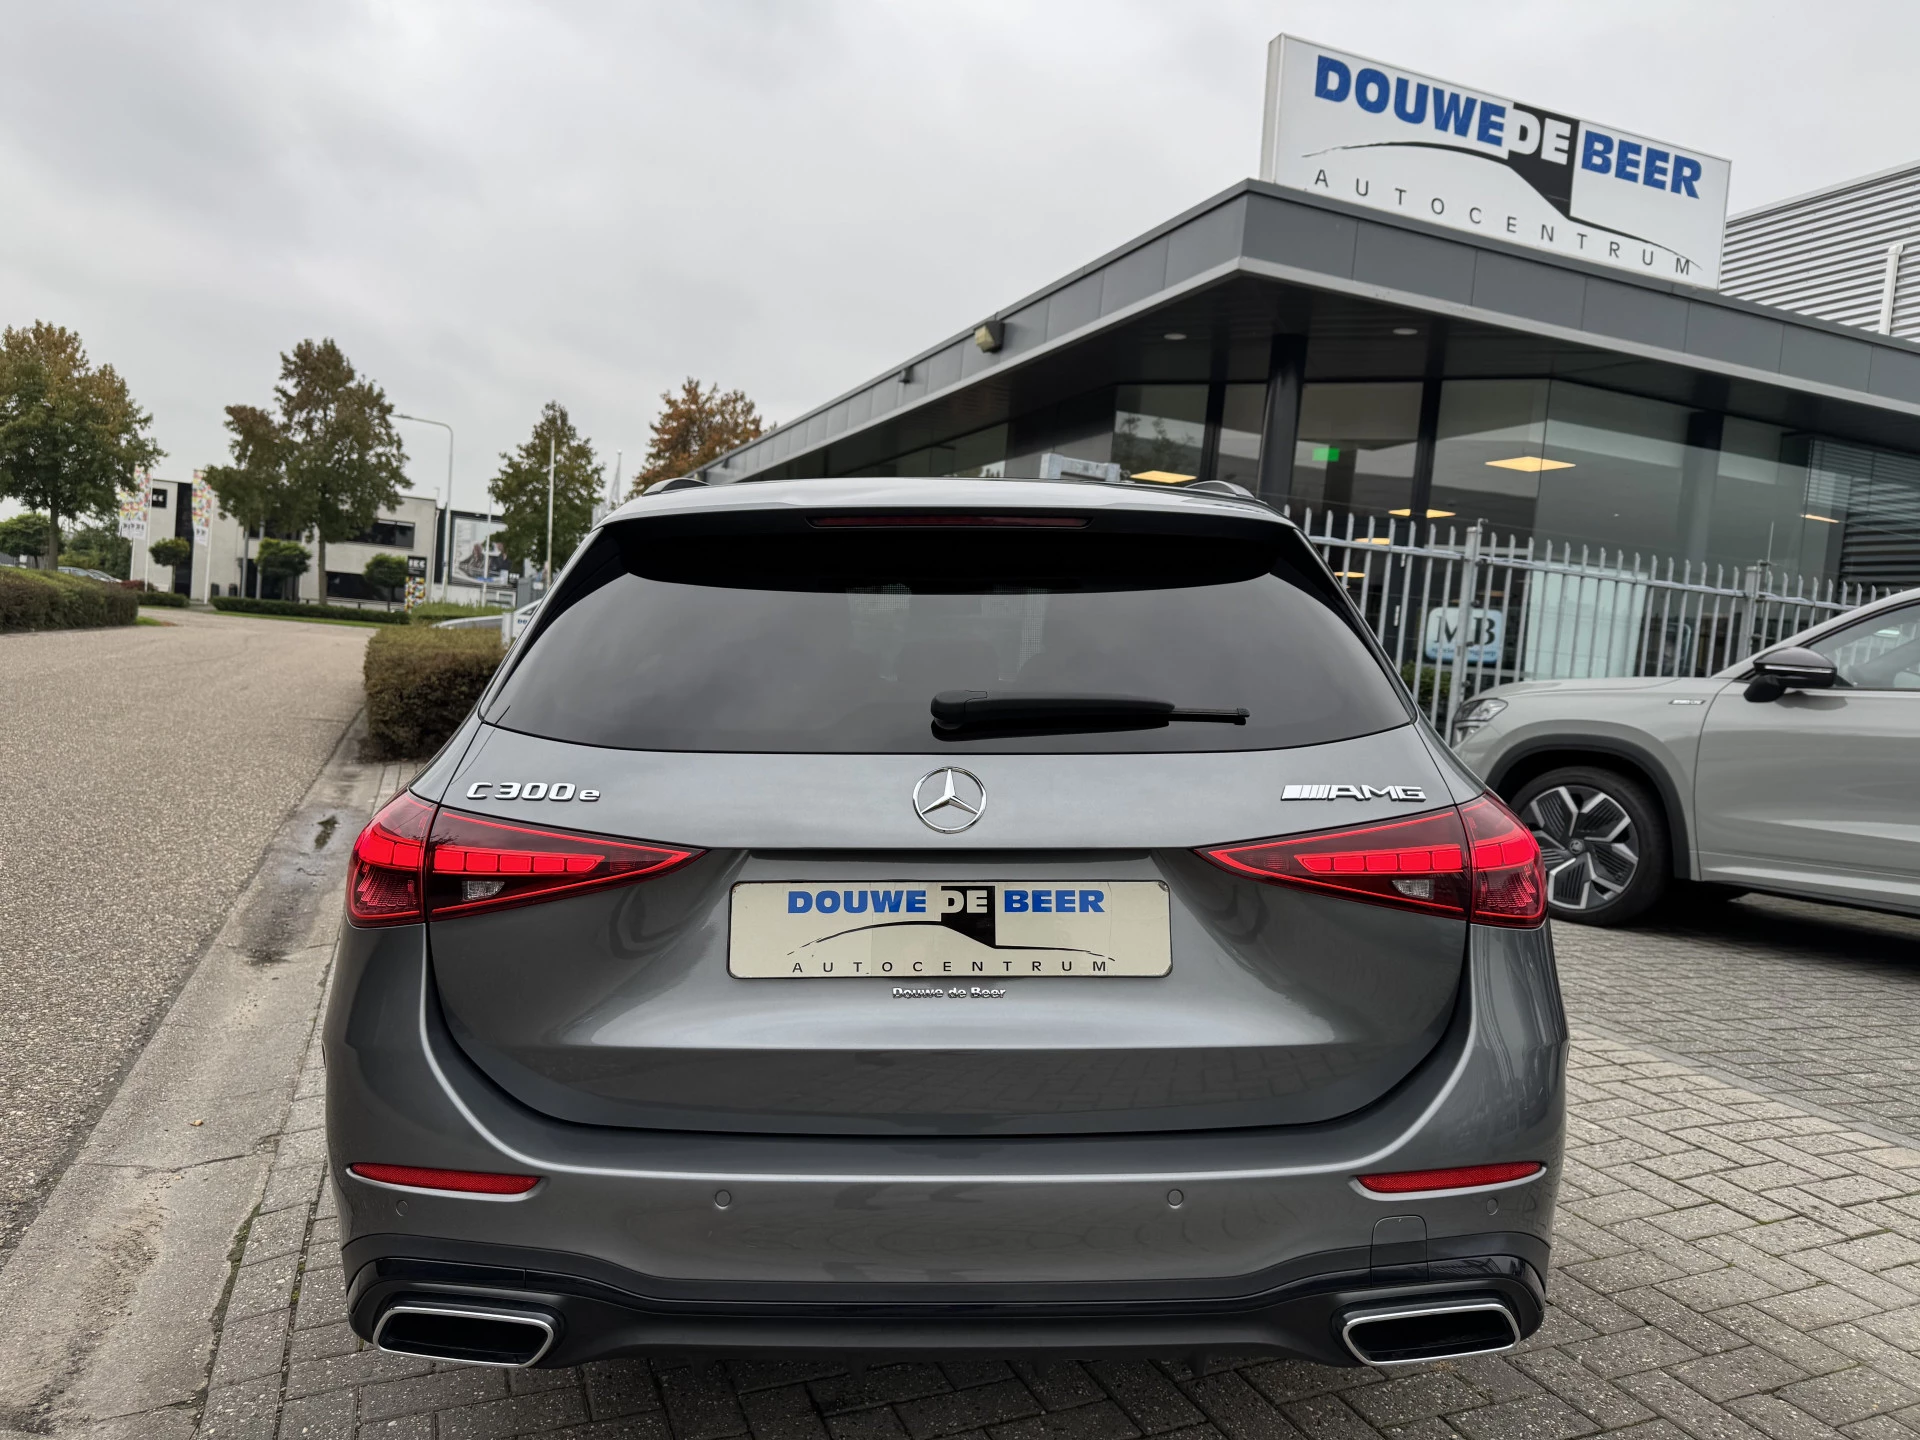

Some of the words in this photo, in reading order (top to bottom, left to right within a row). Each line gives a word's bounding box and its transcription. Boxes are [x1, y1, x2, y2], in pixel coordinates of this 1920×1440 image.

[1314, 54, 1507, 147] DOUWE
[1509, 108, 1572, 166] DE
[1581, 129, 1703, 200] BEER
[1314, 169, 1690, 276] AUTOCENTRUM
[1327, 784, 1427, 802] AMG
[787, 889, 927, 914] DOUWE
[941, 889, 988, 914] DE
[1004, 889, 1105, 914] BEER
[792, 960, 1107, 974] AUTOCENTRUM
[892, 987, 944, 999] Douwe
[948, 987, 967, 999] de
[970, 986, 1006, 999] Beer
